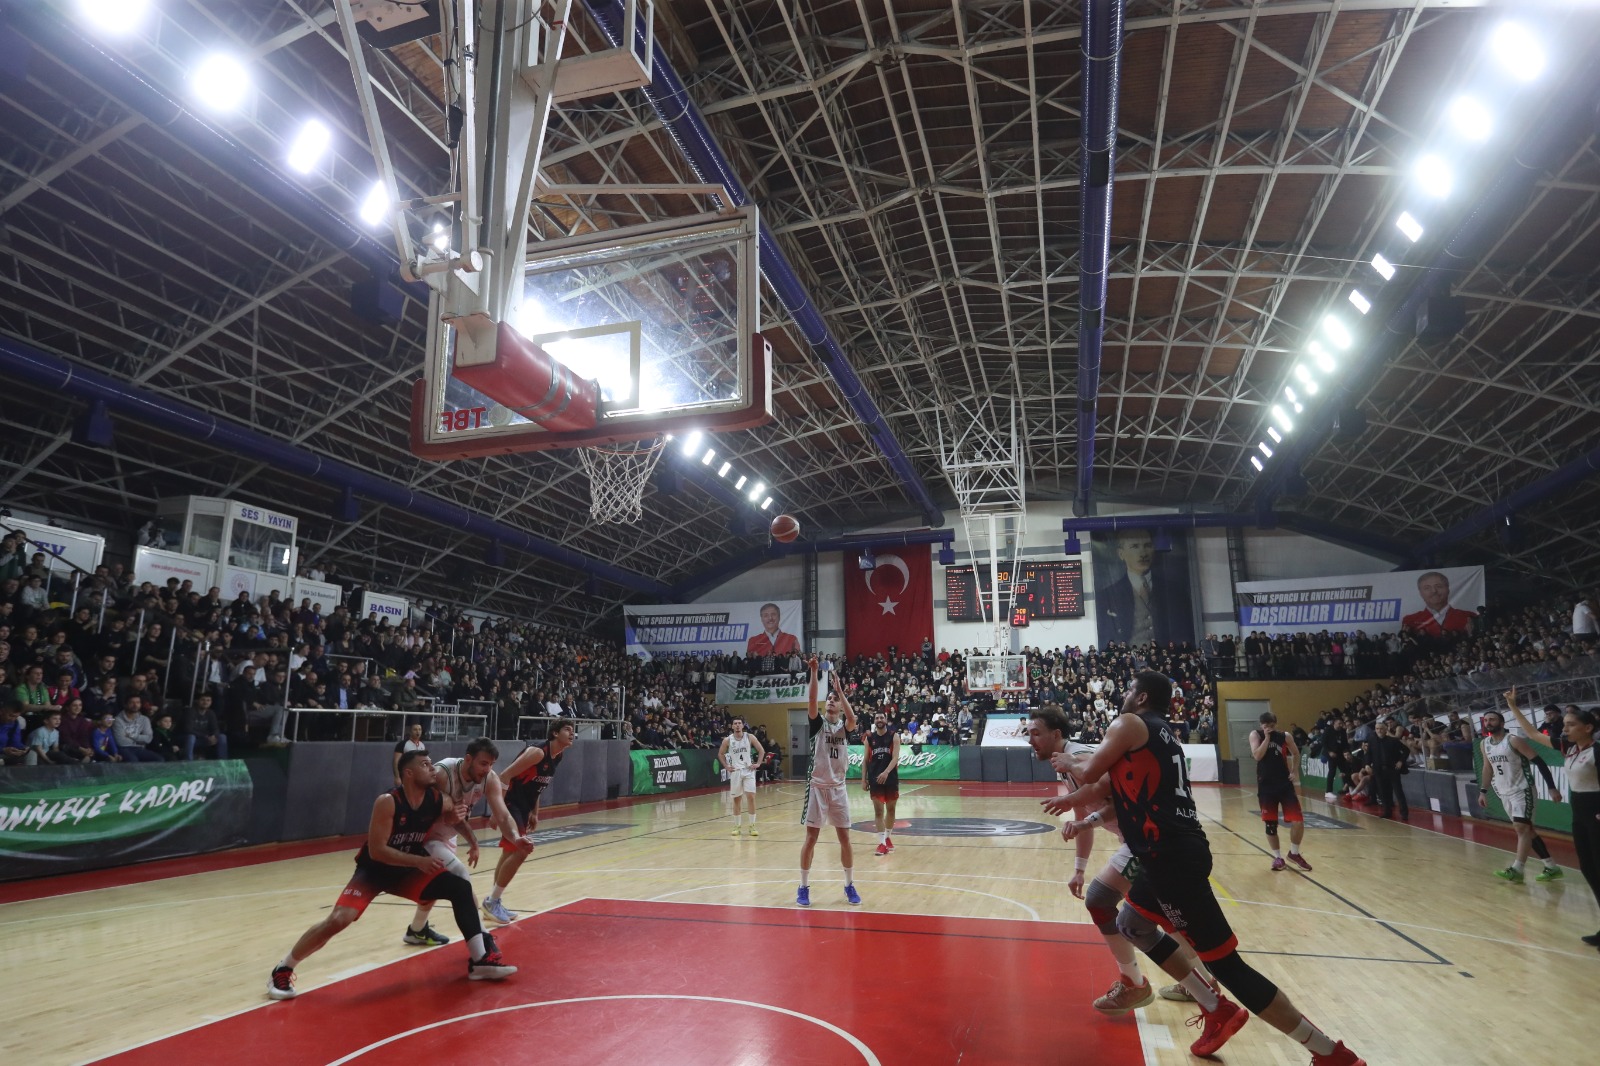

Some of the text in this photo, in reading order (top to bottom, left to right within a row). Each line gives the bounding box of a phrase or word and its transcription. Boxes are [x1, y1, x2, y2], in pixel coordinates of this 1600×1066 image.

[241, 508, 292, 529] SES YAYIN
[34, 540, 67, 555] TV
[997, 572, 1009, 580] 30
[1026, 571, 1035, 579] 14
[1253, 588, 1368, 604] TÜM SPORCU VE ANTRENÖRLERE
[370, 603, 402, 616] BASIN
[1250, 601, 1396, 627] BAŞARILAR DİLERİM
[650, 615, 675, 626] SPORCU
[675, 615, 683, 625] VE
[683, 613, 727, 625] ANTRENÖRLERE
[1013, 614, 1026, 625] 24
[635, 624, 746, 645] BAŞARILAR DİLERİM
[737, 679, 753, 689] BU
[734, 685, 806, 701] ZAFER VAR!
[829, 747, 839, 759] 10
[1496, 765, 1504, 776] 5
[119, 777, 215, 815] KADAR!
